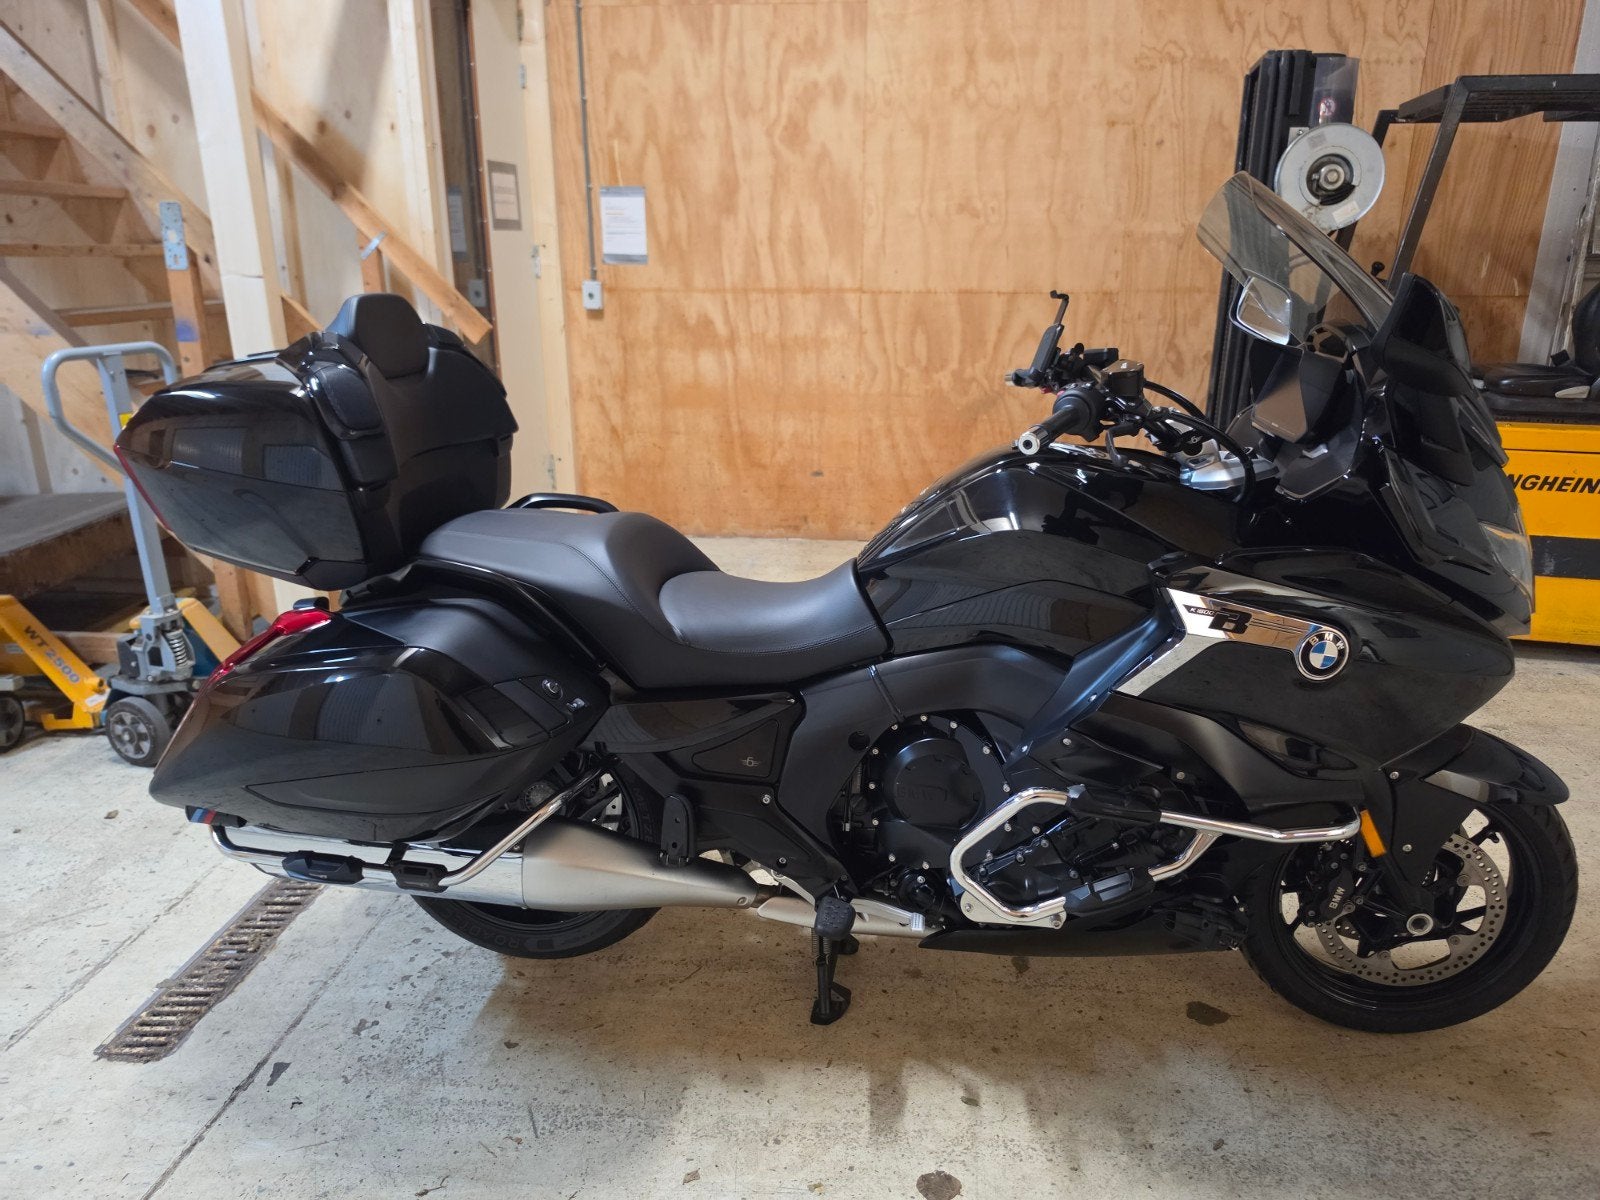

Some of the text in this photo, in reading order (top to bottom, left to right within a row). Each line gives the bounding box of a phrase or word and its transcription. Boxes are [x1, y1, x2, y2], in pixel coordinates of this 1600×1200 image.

[1507, 473, 1600, 495] NGHEIN
[1309, 633, 1346, 651] BMW
[1328, 886, 1346, 910] BMW
